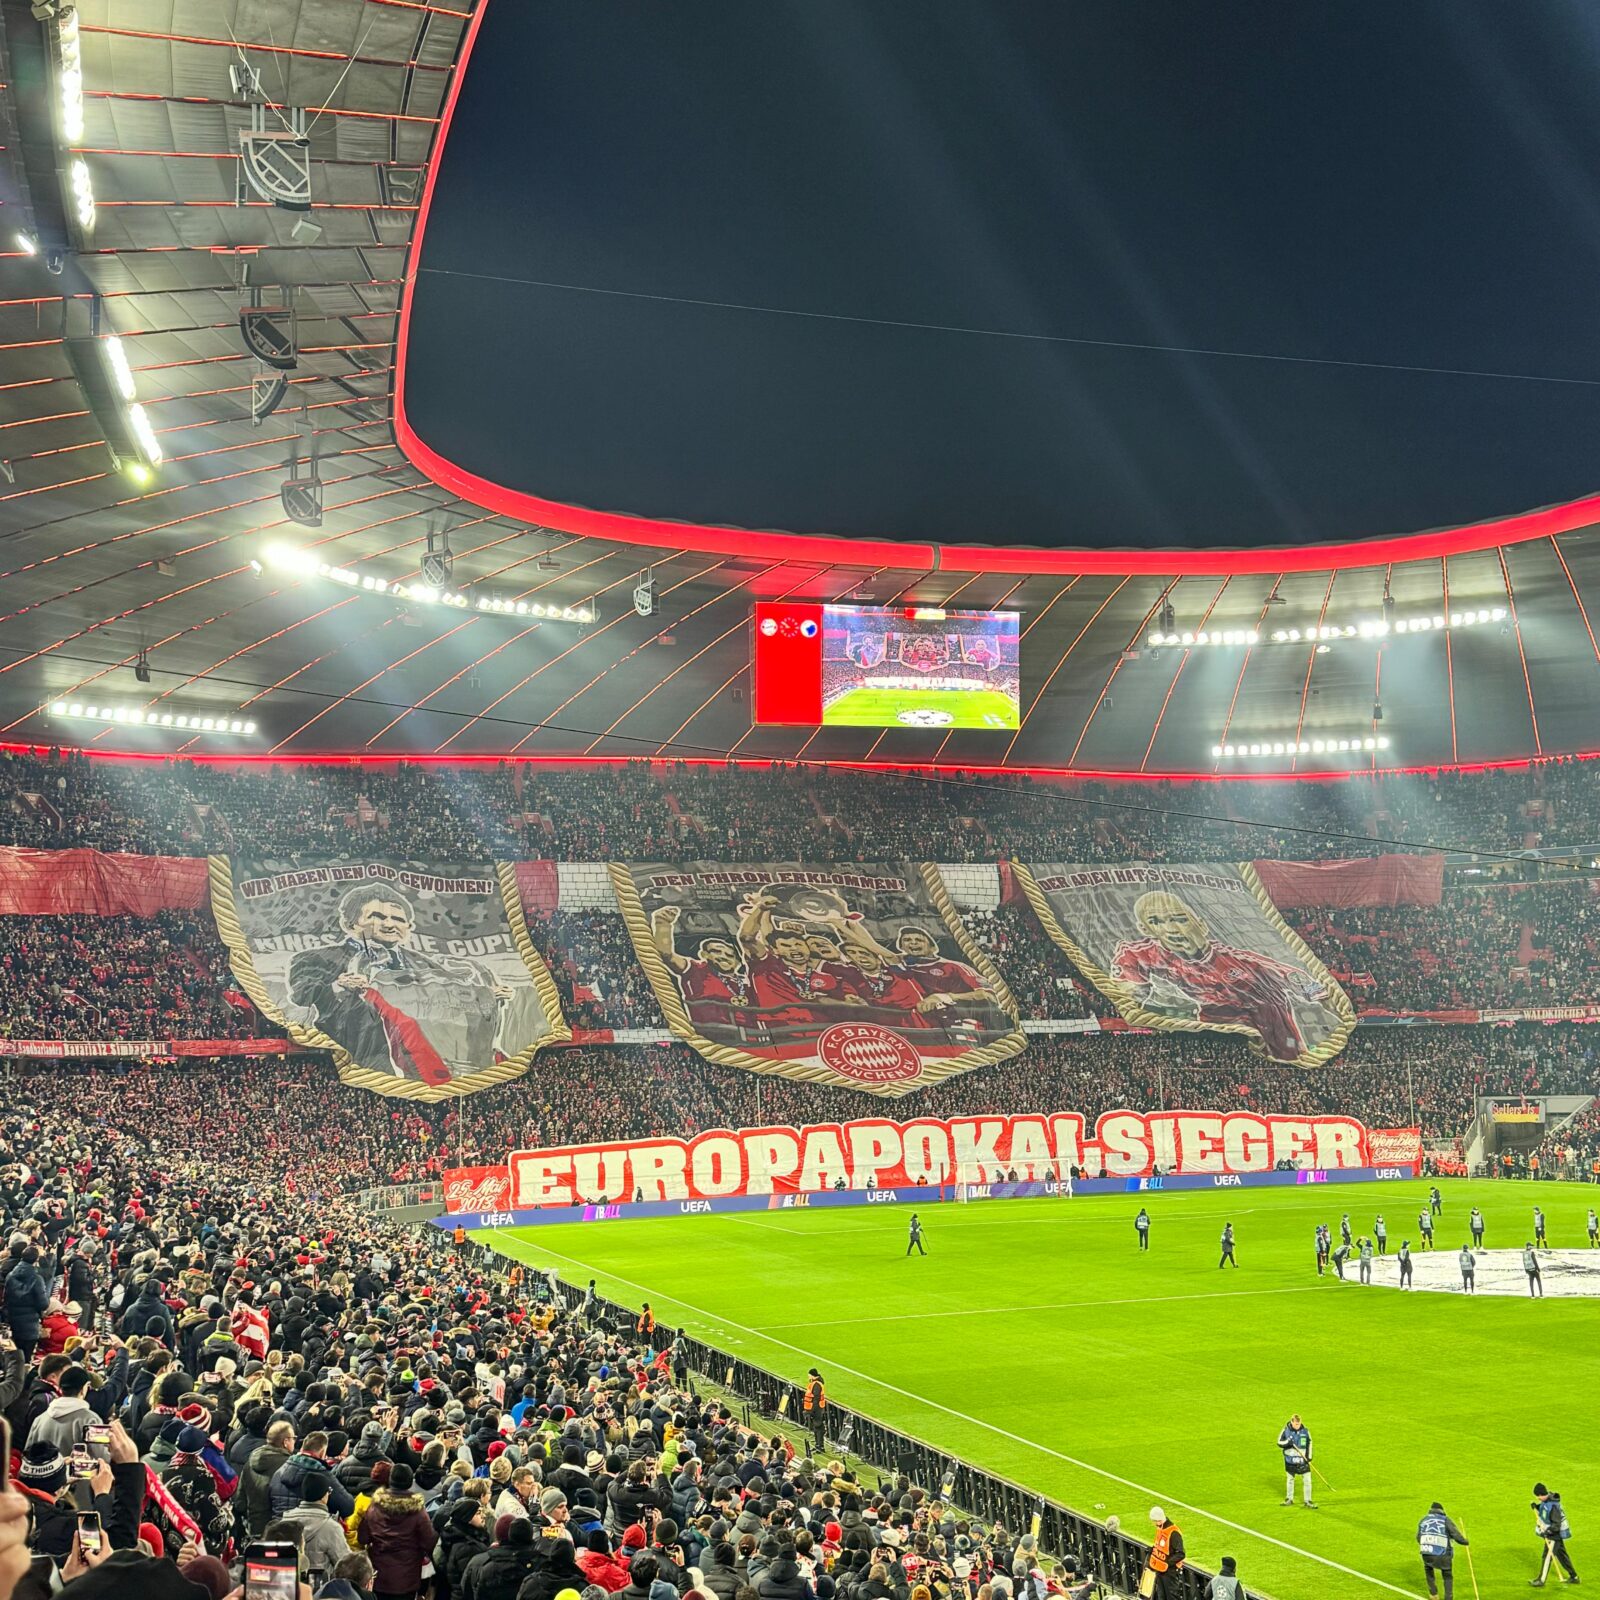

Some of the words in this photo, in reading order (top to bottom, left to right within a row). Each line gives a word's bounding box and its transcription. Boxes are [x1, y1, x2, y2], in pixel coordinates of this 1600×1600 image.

[240, 878, 274, 898] WIR
[275, 868, 329, 890] HABEN
[331, 865, 365, 881] DEN
[366, 864, 397, 880] CUP
[399, 872, 493, 894] GEWONNEN!
[652, 874, 695, 887] DEN
[698, 872, 773, 884] THRON
[776, 872, 907, 892] ERKLOMMEN!
[1036, 876, 1071, 892] DER
[1070, 870, 1113, 888] ARJEN
[1161, 870, 1245, 893] GEMACHT!
[254, 934, 337, 952] KINGS
[447, 933, 514, 957] CUP!
[1523, 1008, 1586, 1020] WALDKIRCHEN
[842, 1028, 906, 1051] BAYERN
[1368, 1132, 1420, 1150] Wembley
[518, 1114, 1362, 1206] EUROPAPOKALSIEGER
[1373, 1148, 1419, 1162] Stadion
[1214, 1175, 1242, 1186] UEFA
[1375, 1168, 1402, 1180] UEFA
[1045, 1182, 1073, 1193] UEFA
[1149, 1177, 1164, 1189] ALL
[793, 1193, 810, 1207] ALL
[866, 1190, 897, 1202] UEFA
[460, 1195, 496, 1214] 2013
[681, 1201, 711, 1212] UEFA
[481, 1213, 514, 1226] UEFA
